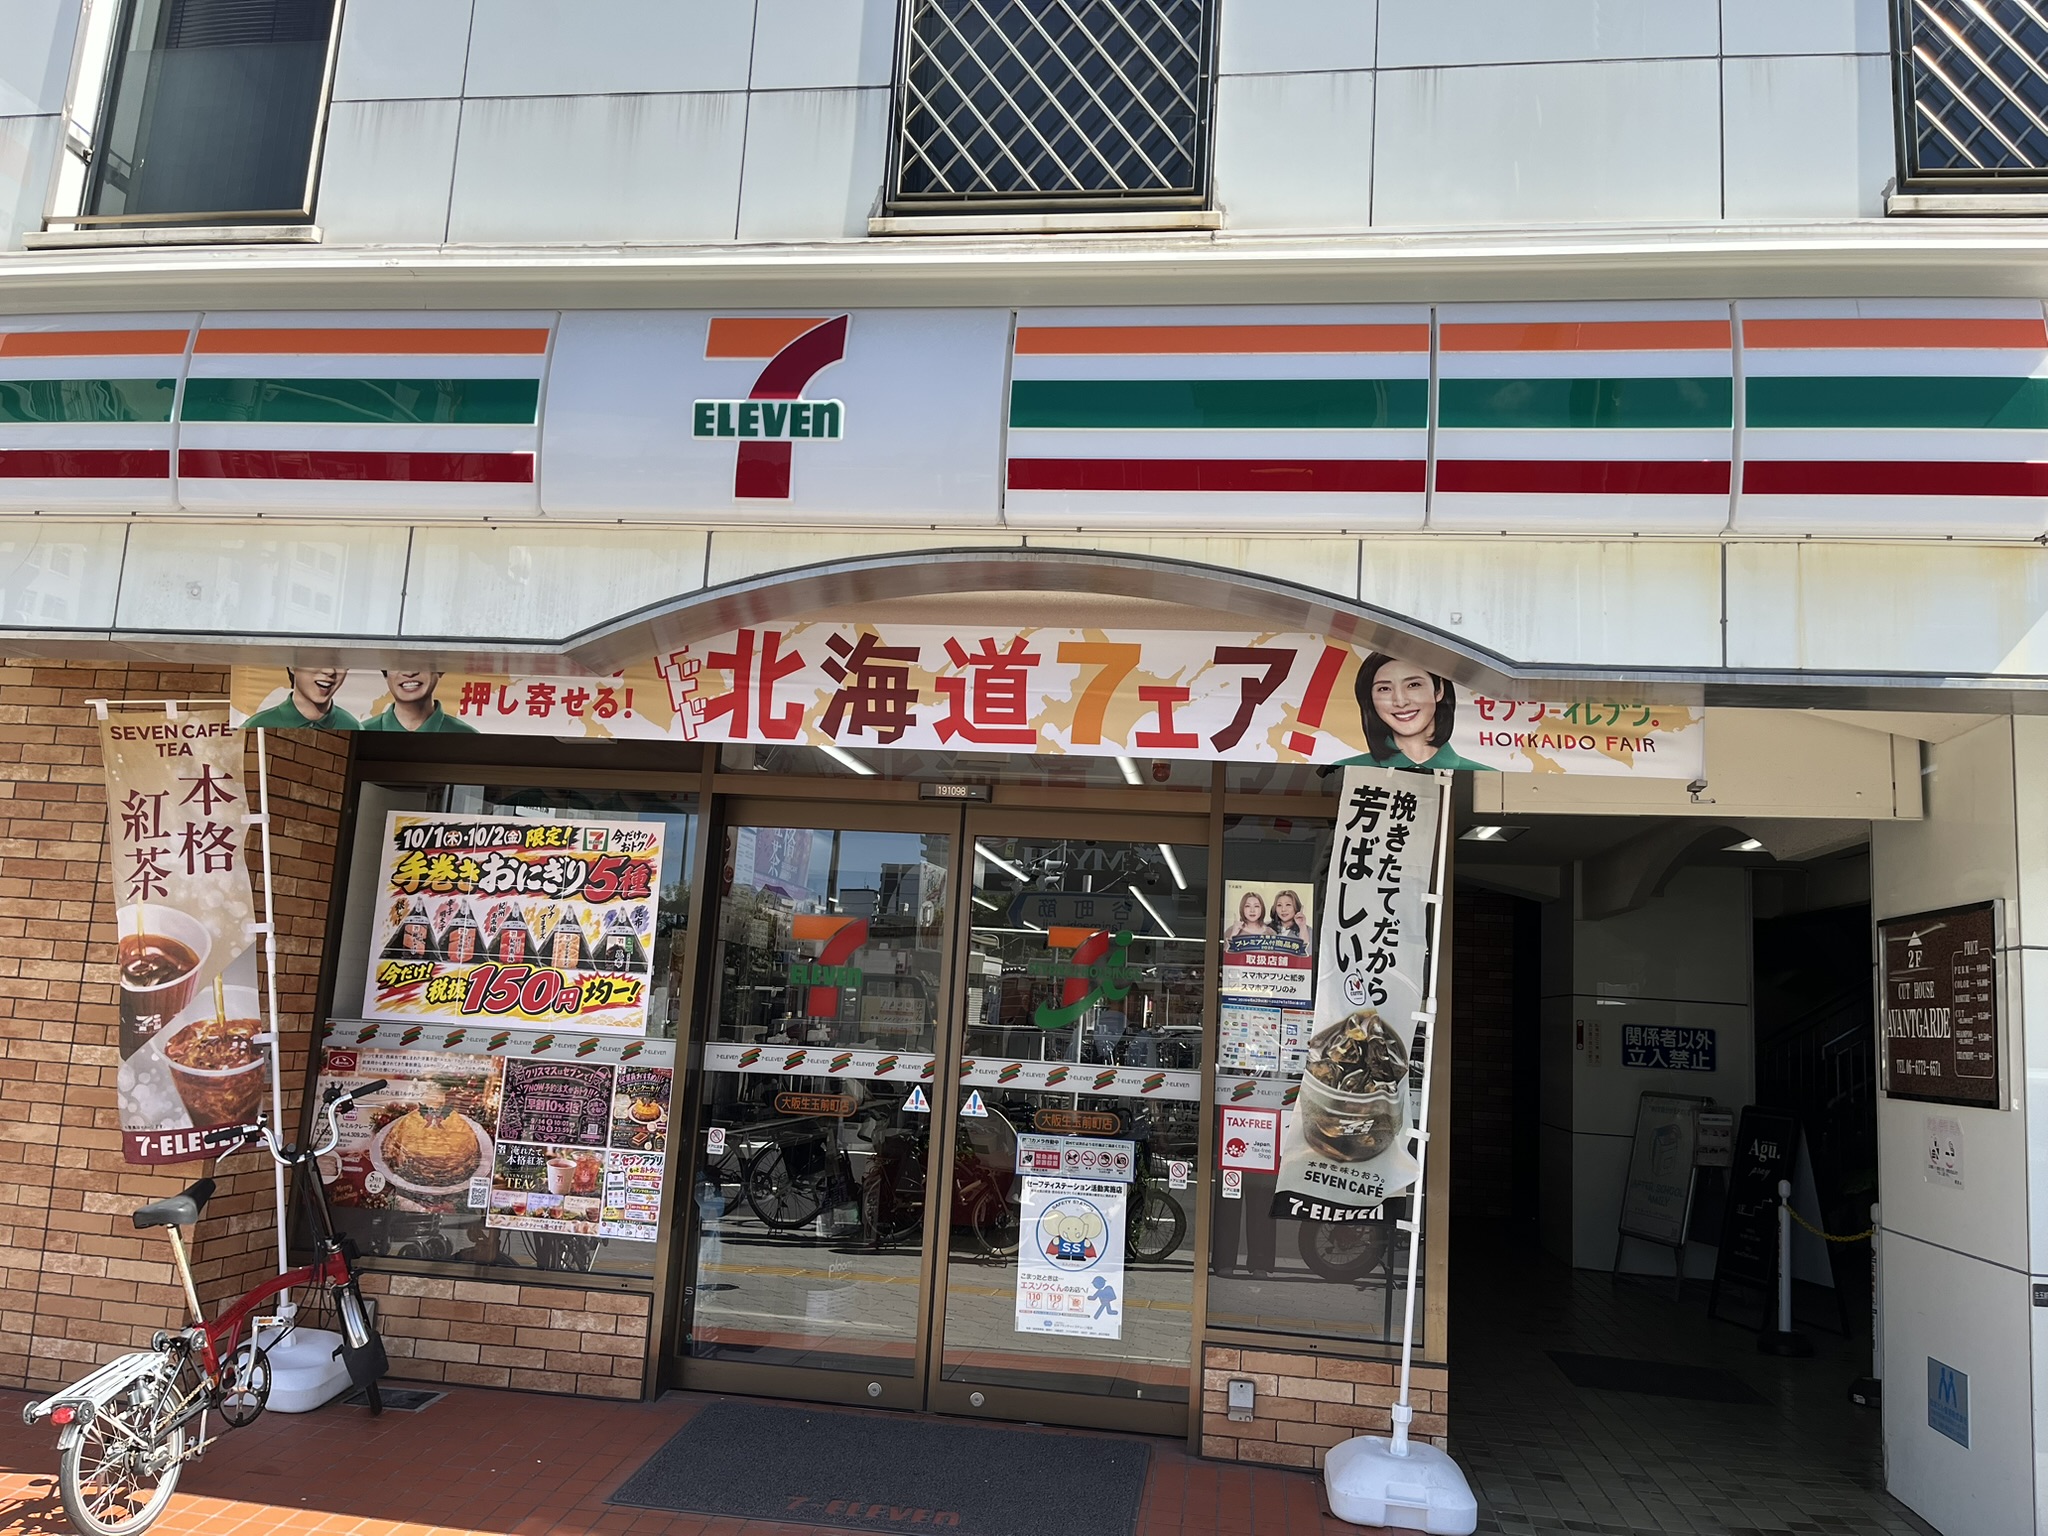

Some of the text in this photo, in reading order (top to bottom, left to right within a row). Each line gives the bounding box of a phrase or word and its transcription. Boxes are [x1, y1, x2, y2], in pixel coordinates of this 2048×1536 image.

[704, 314, 848, 498] 7
[460, 681, 634, 719] 押し寄せる!
[110, 724, 178, 741] SEVEN
[156, 743, 194, 757] TEA
[1479, 731, 1656, 753] HOKKAIDO FAIR
[938, 785, 966, 797] 191098
[178, 764, 238, 875] 本格
[120, 789, 172, 900] 紅茶
[611, 829, 647, 844] 今だけの
[1335, 785, 1391, 973] 芳ばしい
[1365, 790, 1418, 1006] 挽きたてだから
[1245, 954, 1289, 967] 取扱店舗
[1908, 950, 1922, 968] 2F
[1241, 971, 1305, 982] スマホアプリと紙券
[462, 965, 582, 1015] 150円
[1241, 983, 1297, 993] スマホアプリのみ
[1898, 981, 1935, 999] CUT HOUSE
[1887, 1007, 1951, 1040] AVANTGARDE
[1625, 1026, 1713, 1050] 関係者以外
[1627, 1047, 1711, 1070] 立入禁止
[781, 1097, 850, 1113] 大阪生玉前町店
[1041, 1114, 1114, 1131] 大阪生玉前町店
[1227, 1117, 1272, 1130] TAX-FREE
[1308, 1160, 1386, 1184] 本物を味わおう。
[505, 1178, 530, 1190] TEA
[1304, 1170, 1384, 1198] SEVEN CAFÉ
[1062, 1242, 1081, 1254] SS
[1028, 1292, 1062, 1302] 110 119
